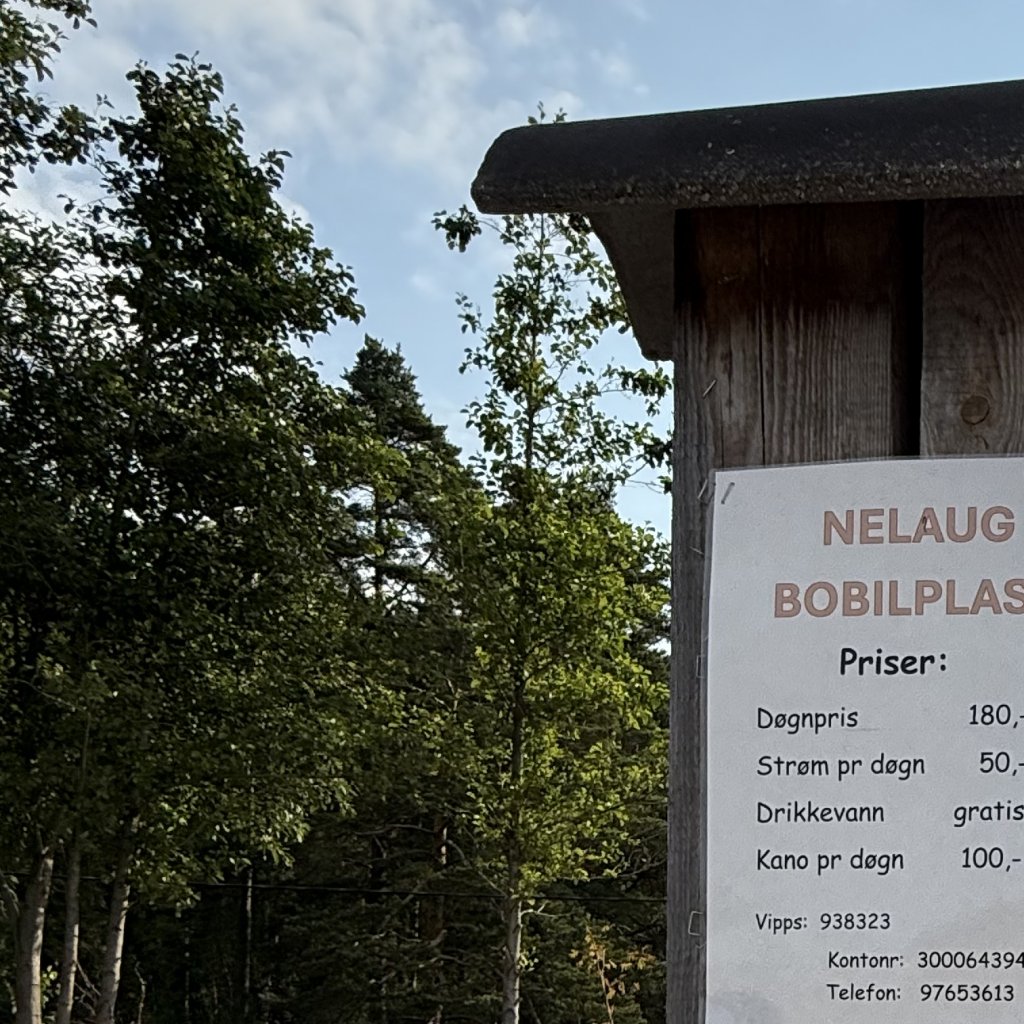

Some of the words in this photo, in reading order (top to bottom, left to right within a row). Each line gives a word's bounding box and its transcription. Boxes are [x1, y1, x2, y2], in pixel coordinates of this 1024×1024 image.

[824, 506, 1015, 546] NELAUG
[840, 648, 946, 676] Priser:
[757, 707, 859, 735] Døgnpris
[757, 755, 829, 776] Strøm
[838, 759, 862, 782] pr
[871, 752, 925, 781] døgn
[757, 800, 884, 823] Drikkevann
[954, 800, 1024, 827] gratis
[757, 849, 808, 871] Kano
[817, 854, 842, 877] pr
[850, 847, 904, 876] døgn
[962, 847, 1021, 872] 100,-
[755, 913, 807, 935] Vipps:
[819, 913, 890, 932] 938323
[829, 951, 904, 969] Kontonr:
[826, 983, 901, 1001] Telefon:
[920, 984, 1014, 1002] 97653613
